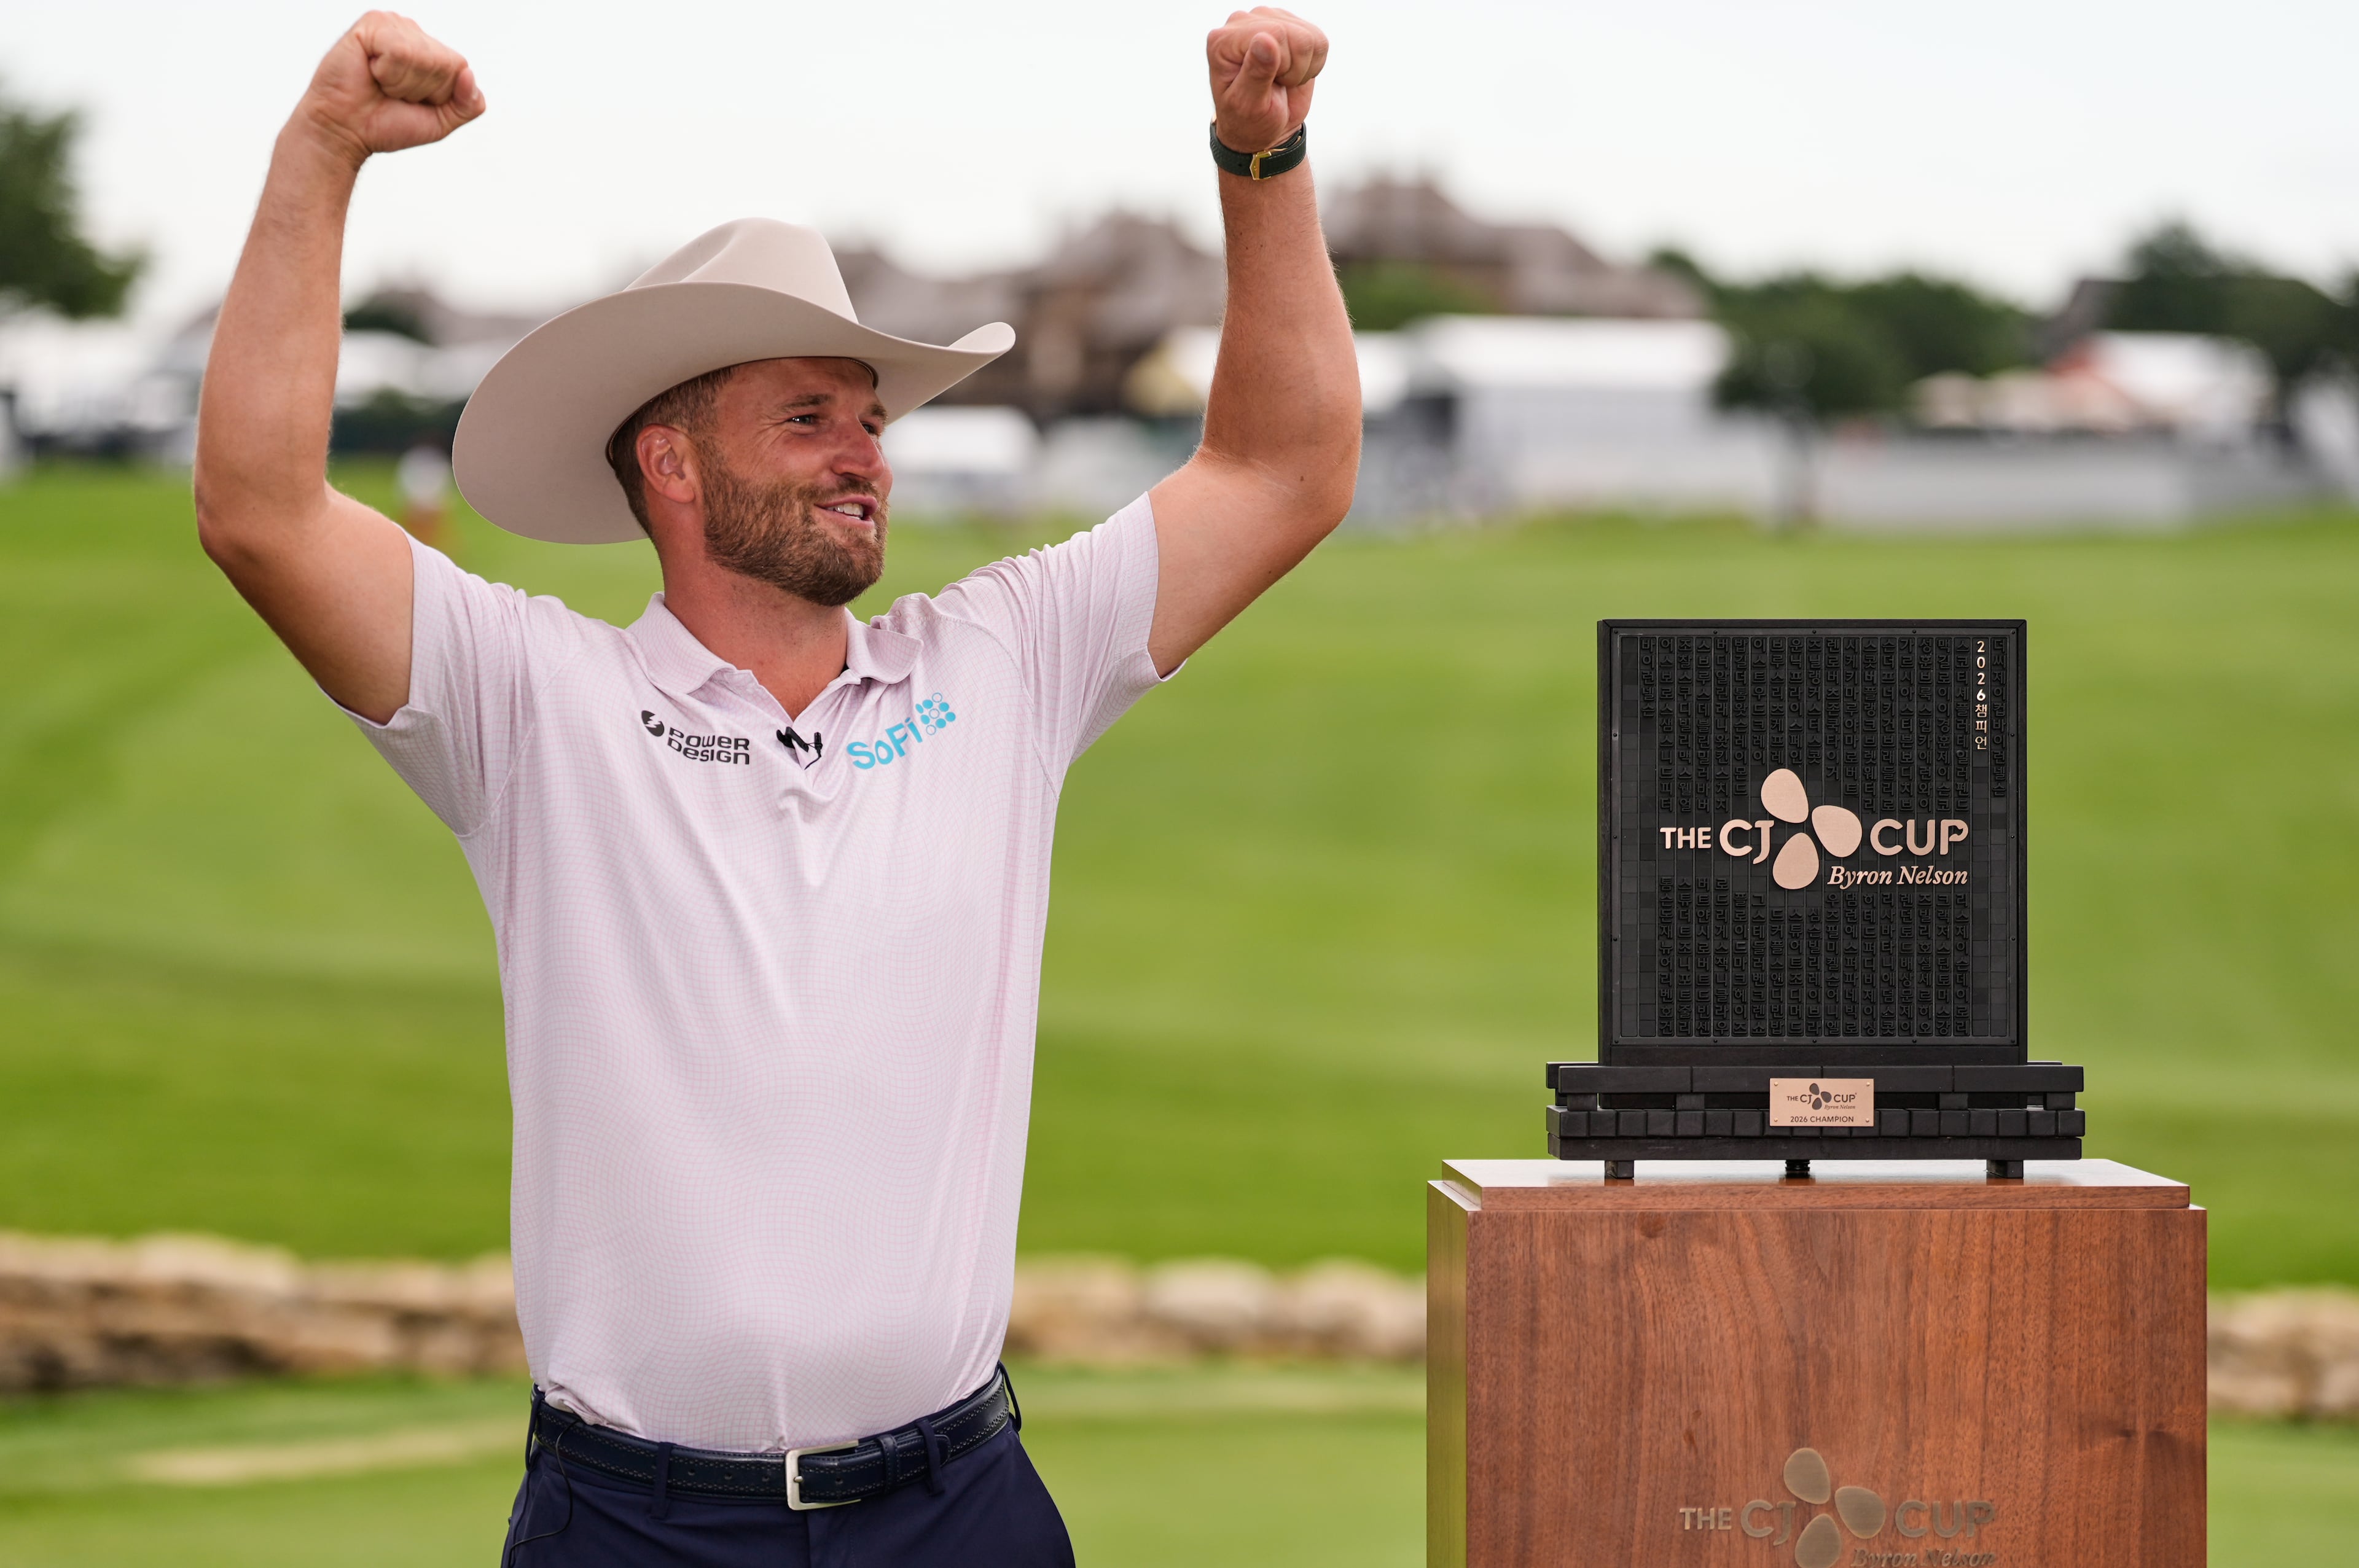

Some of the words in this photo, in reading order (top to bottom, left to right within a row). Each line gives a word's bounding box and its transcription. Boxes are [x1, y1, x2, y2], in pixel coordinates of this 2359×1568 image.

[1974, 641, 1988, 750] 2026챔피언
[847, 717, 923, 770] SoFi
[1660, 827, 1712, 849] THE
[1719, 819, 1774, 865] CJ
[1870, 819, 1968, 856] CUP
[1827, 866, 1892, 890] Byron
[1896, 865, 1968, 885] Nelson
[1800, 1094, 1812, 1104] CJ
[1833, 1094, 1856, 1103] CUP
[1680, 1508, 1732, 1530] THE
[1740, 1499, 1796, 1546] CJ
[1896, 1500, 1995, 1537] CUP
[1850, 1547, 1917, 1568] Byron
[1921, 1547, 1995, 1566] Nelson
